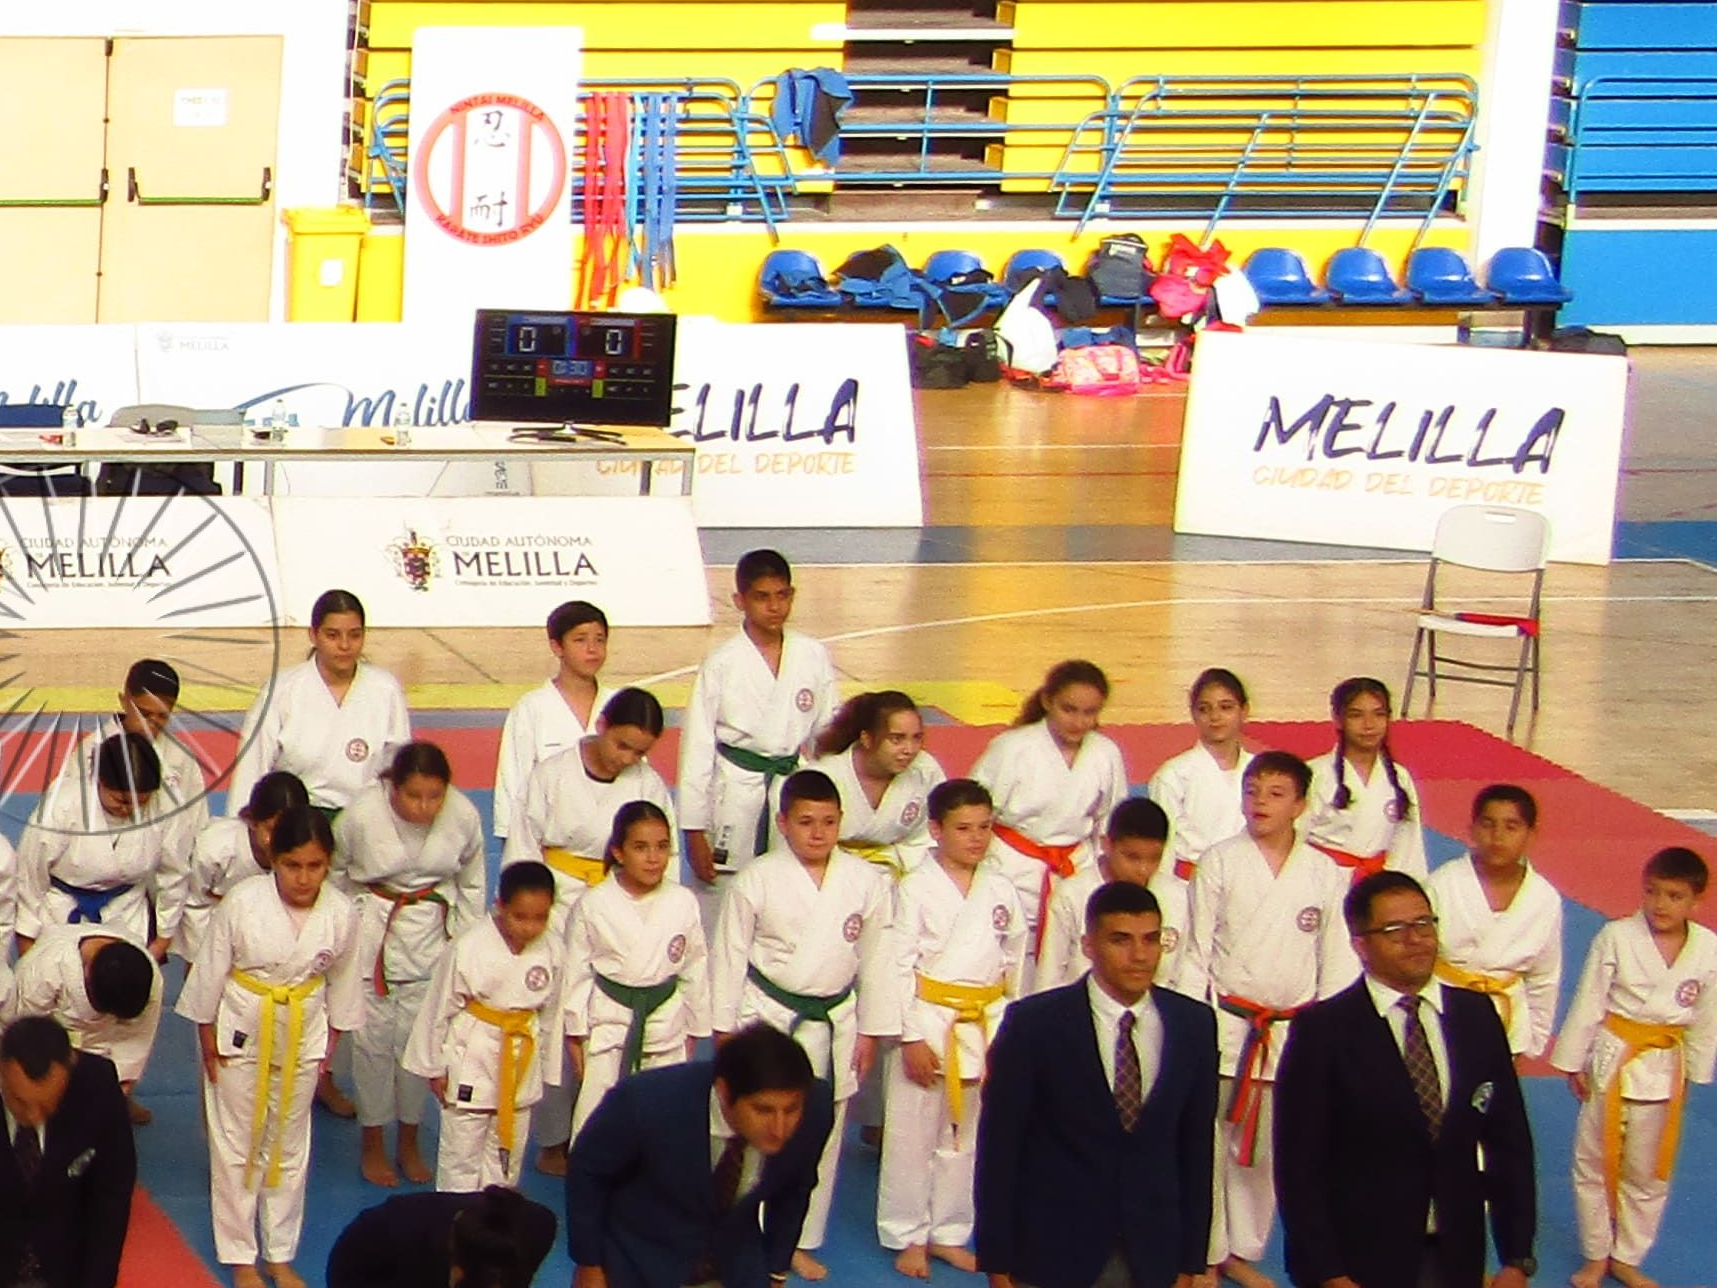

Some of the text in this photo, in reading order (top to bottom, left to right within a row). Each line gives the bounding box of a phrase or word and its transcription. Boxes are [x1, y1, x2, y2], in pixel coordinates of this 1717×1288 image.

[436, 213, 479, 244] KARATE
[1253, 394, 1566, 474] MELILLA
[698, 453, 742, 474] DEL
[756, 452, 855, 474] DEPORTE
[1253, 465, 1547, 505] CIUDAD DEL DEPORTE
[446, 533, 592, 547] CIUDAD AUTÓNOMA
[26, 552, 171, 578] MELILLA
[452, 551, 599, 576] MELILLA
